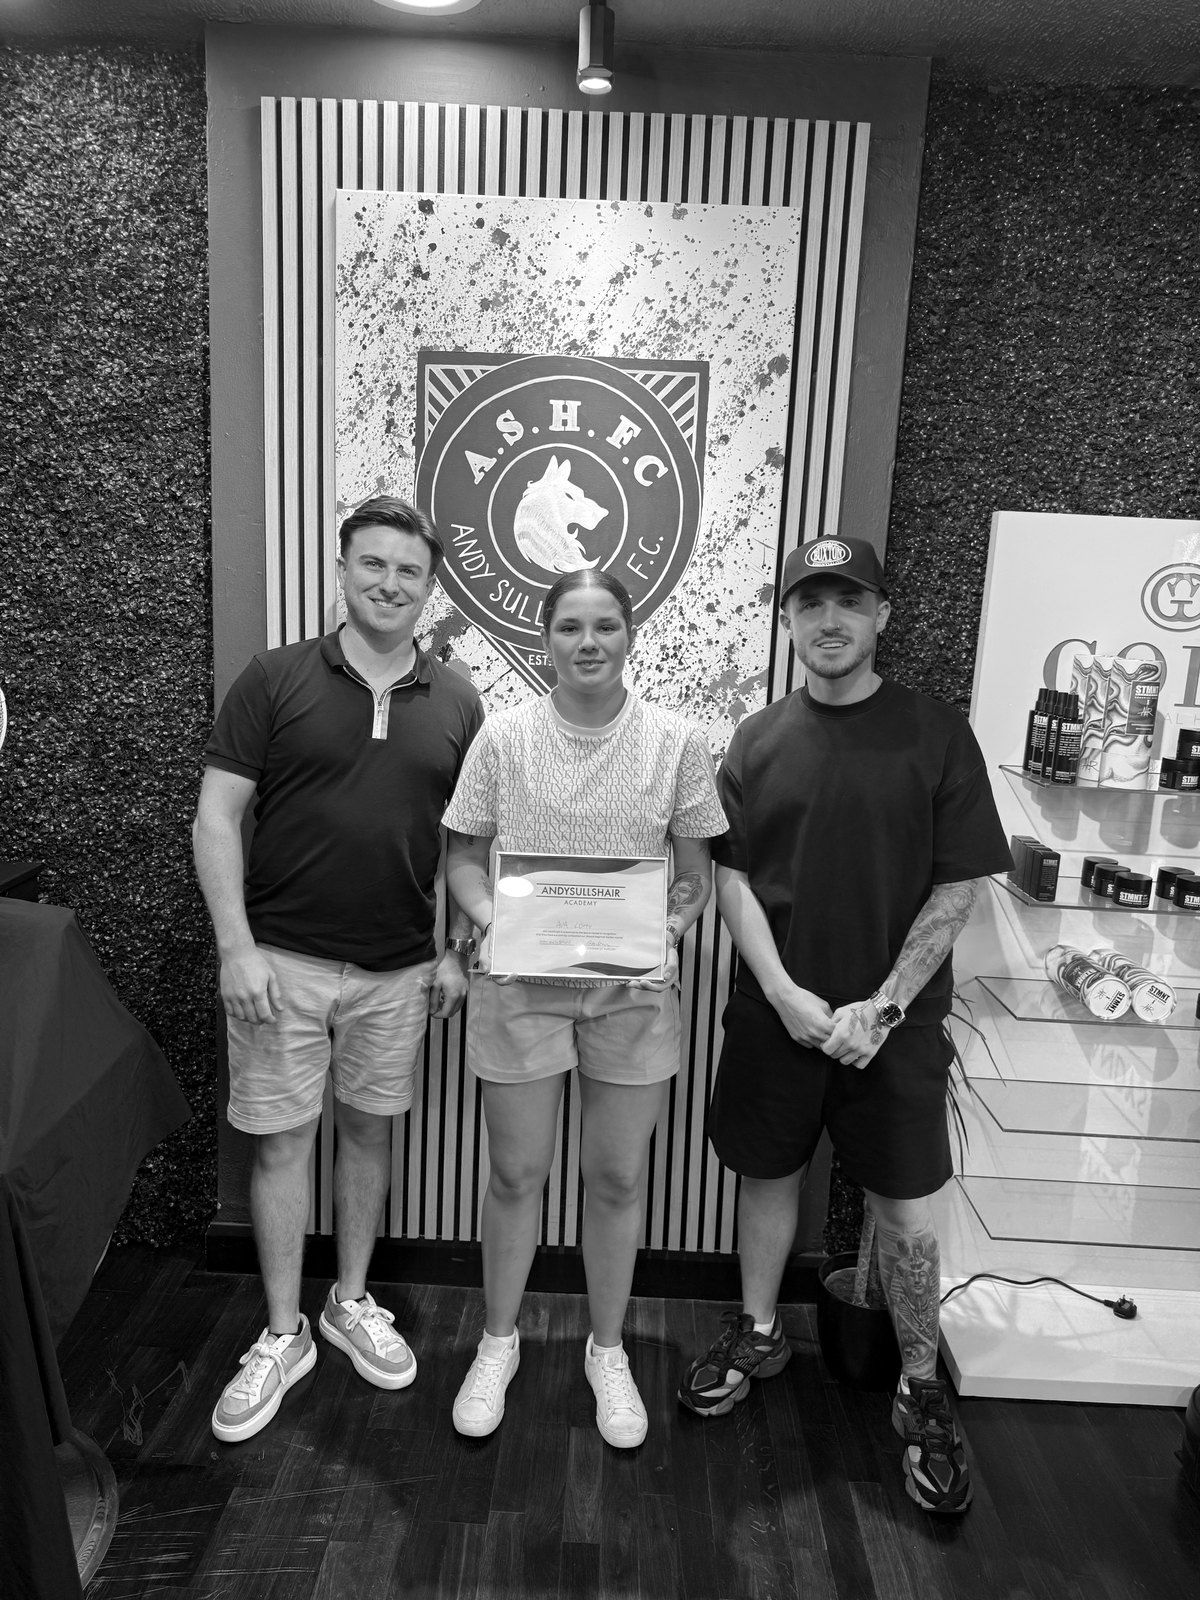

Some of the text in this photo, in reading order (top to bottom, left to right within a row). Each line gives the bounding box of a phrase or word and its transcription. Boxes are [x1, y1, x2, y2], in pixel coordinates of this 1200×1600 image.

[450, 523, 664, 627] ANDY SULL F.C.
[541, 886, 621, 898] ANDYSULLSHAIR
[1119, 891, 1143, 902] STMNT
[1184, 895, 1200, 904] STM
[1149, 985, 1171, 1001] STMNT
[1108, 992, 1126, 1014] STMNT
